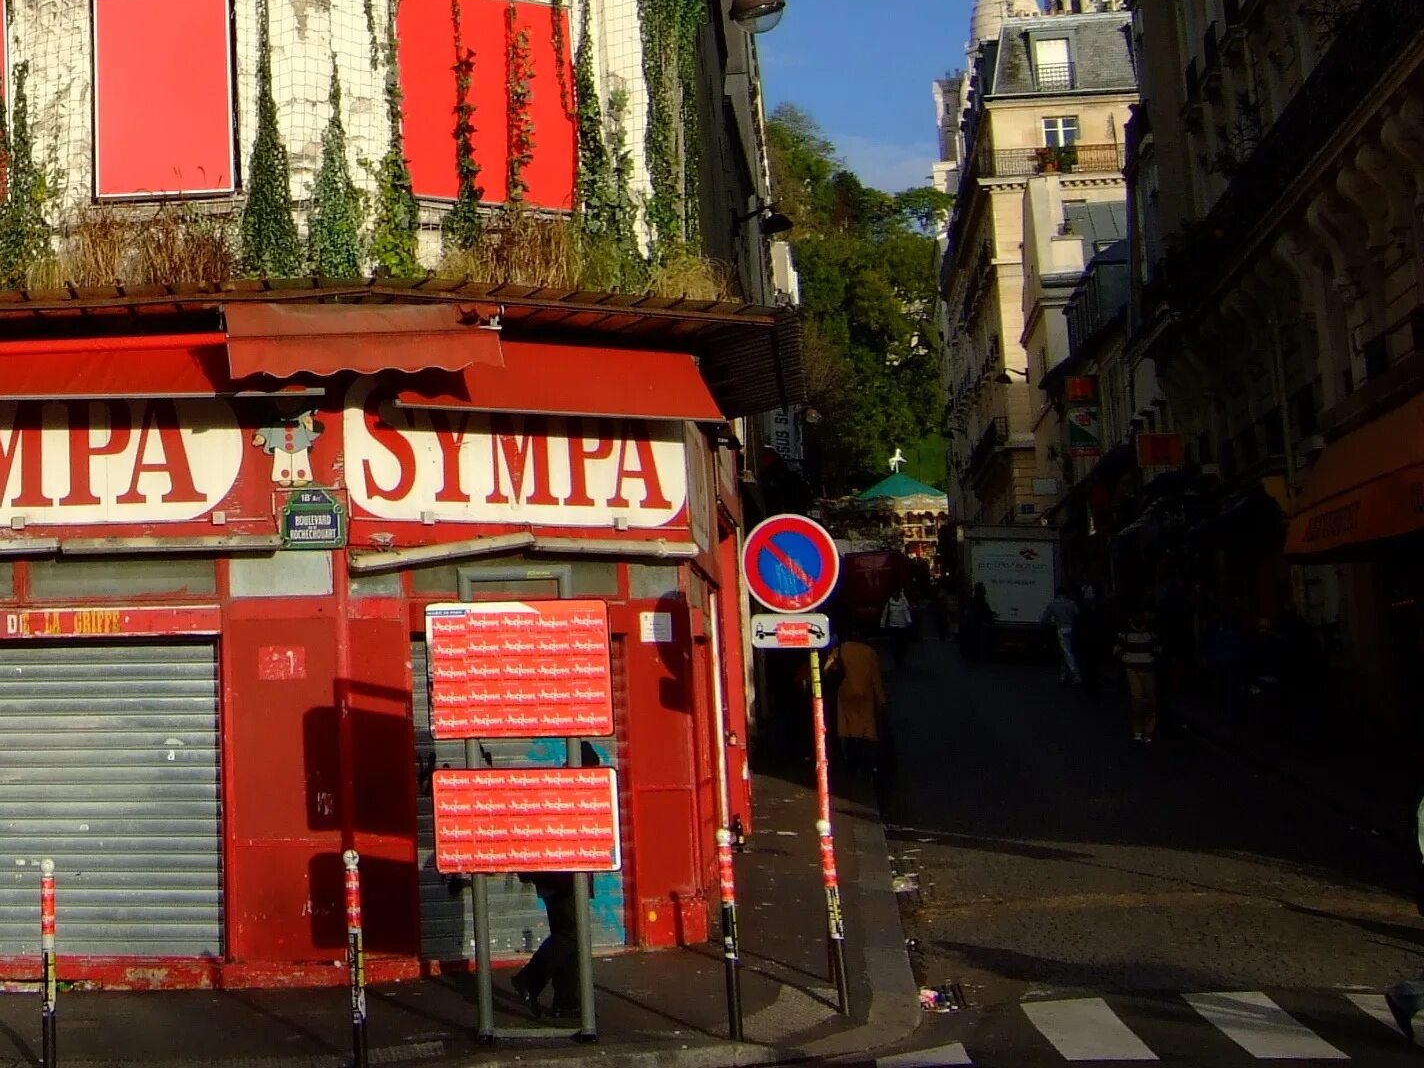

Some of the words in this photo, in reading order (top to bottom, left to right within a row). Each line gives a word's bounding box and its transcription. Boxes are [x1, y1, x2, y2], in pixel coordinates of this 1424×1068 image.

[362, 385, 672, 509] SYMPA
[295, 515, 332, 526] BOULEVARD
[290, 529, 336, 540] ROCHECHOUART
